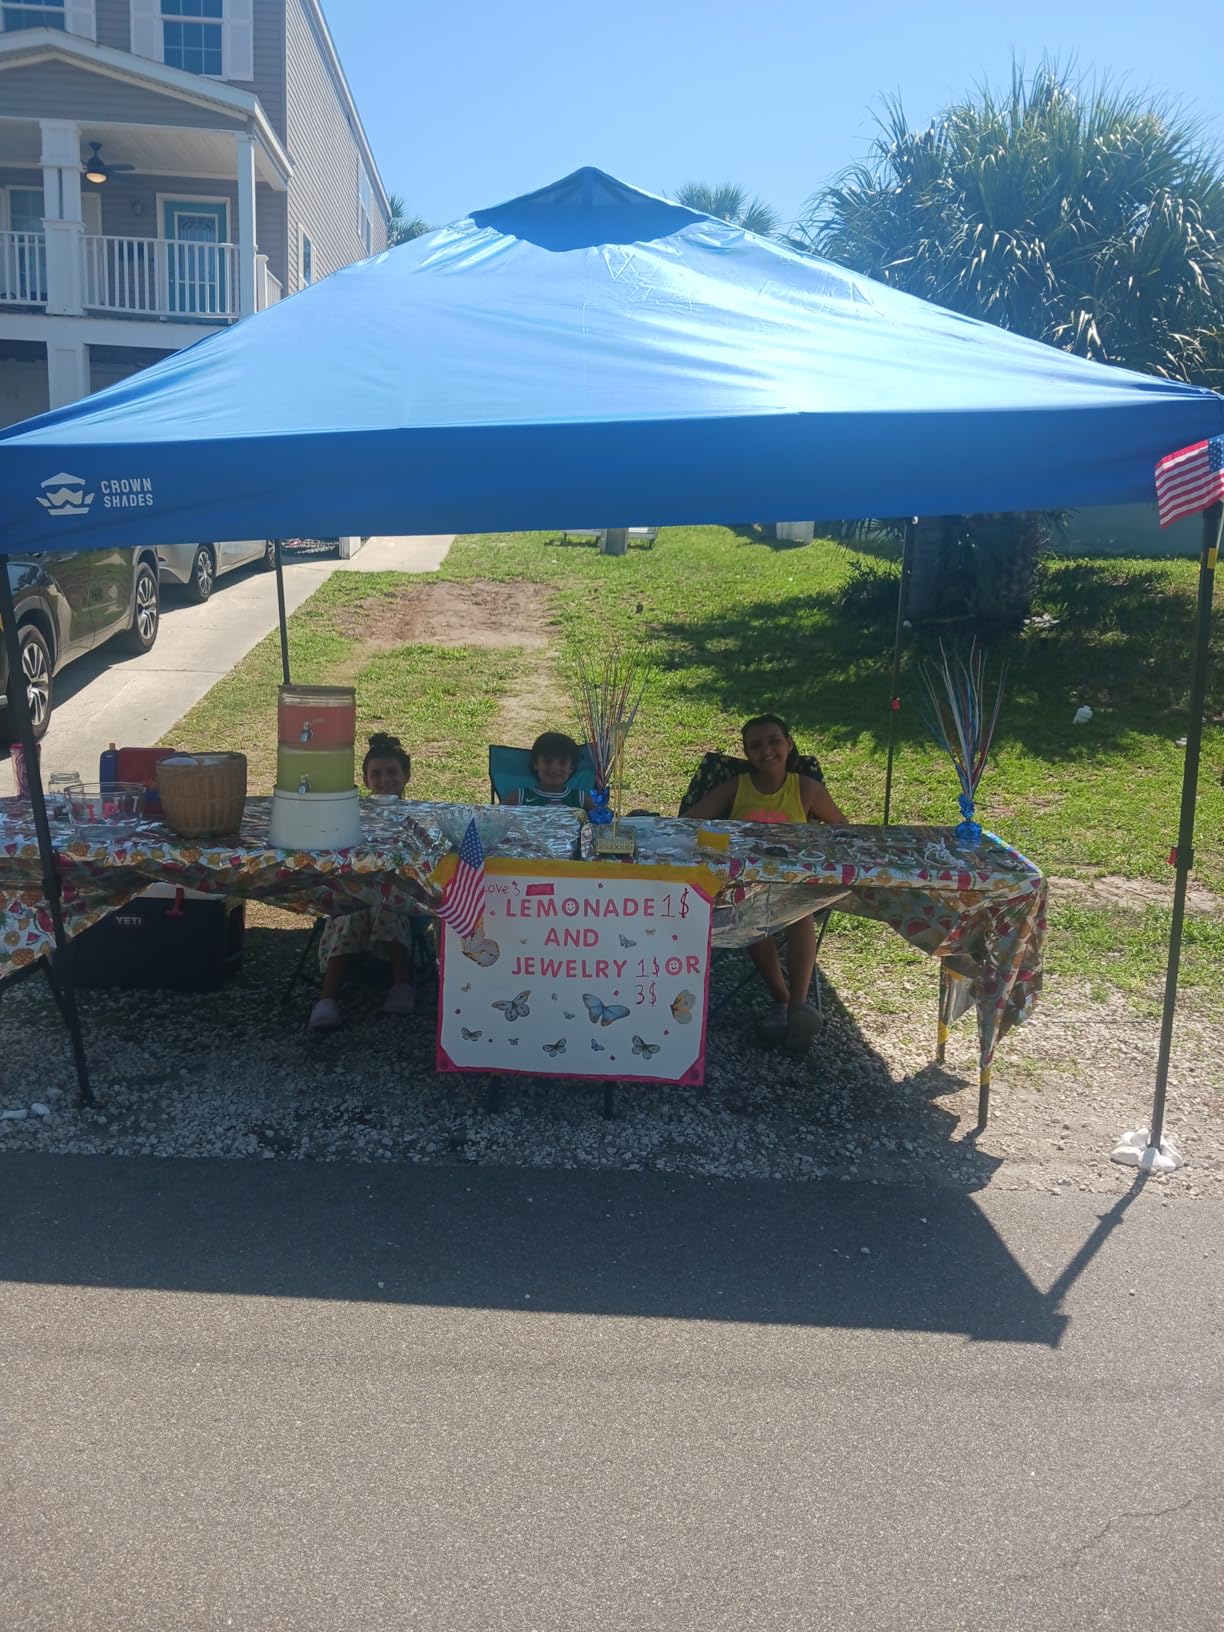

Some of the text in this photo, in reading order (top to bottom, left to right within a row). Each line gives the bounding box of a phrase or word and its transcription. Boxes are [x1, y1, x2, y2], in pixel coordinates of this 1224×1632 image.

[101, 478, 152, 493] CROWN
[104, 494, 153, 508] SHADES
[506, 898, 655, 917] LEMONADE
[116, 916, 142, 925] YETI
[544, 928, 599, 947] AND
[512, 957, 628, 978] JEWELRY
[665, 955, 700, 976] OR
